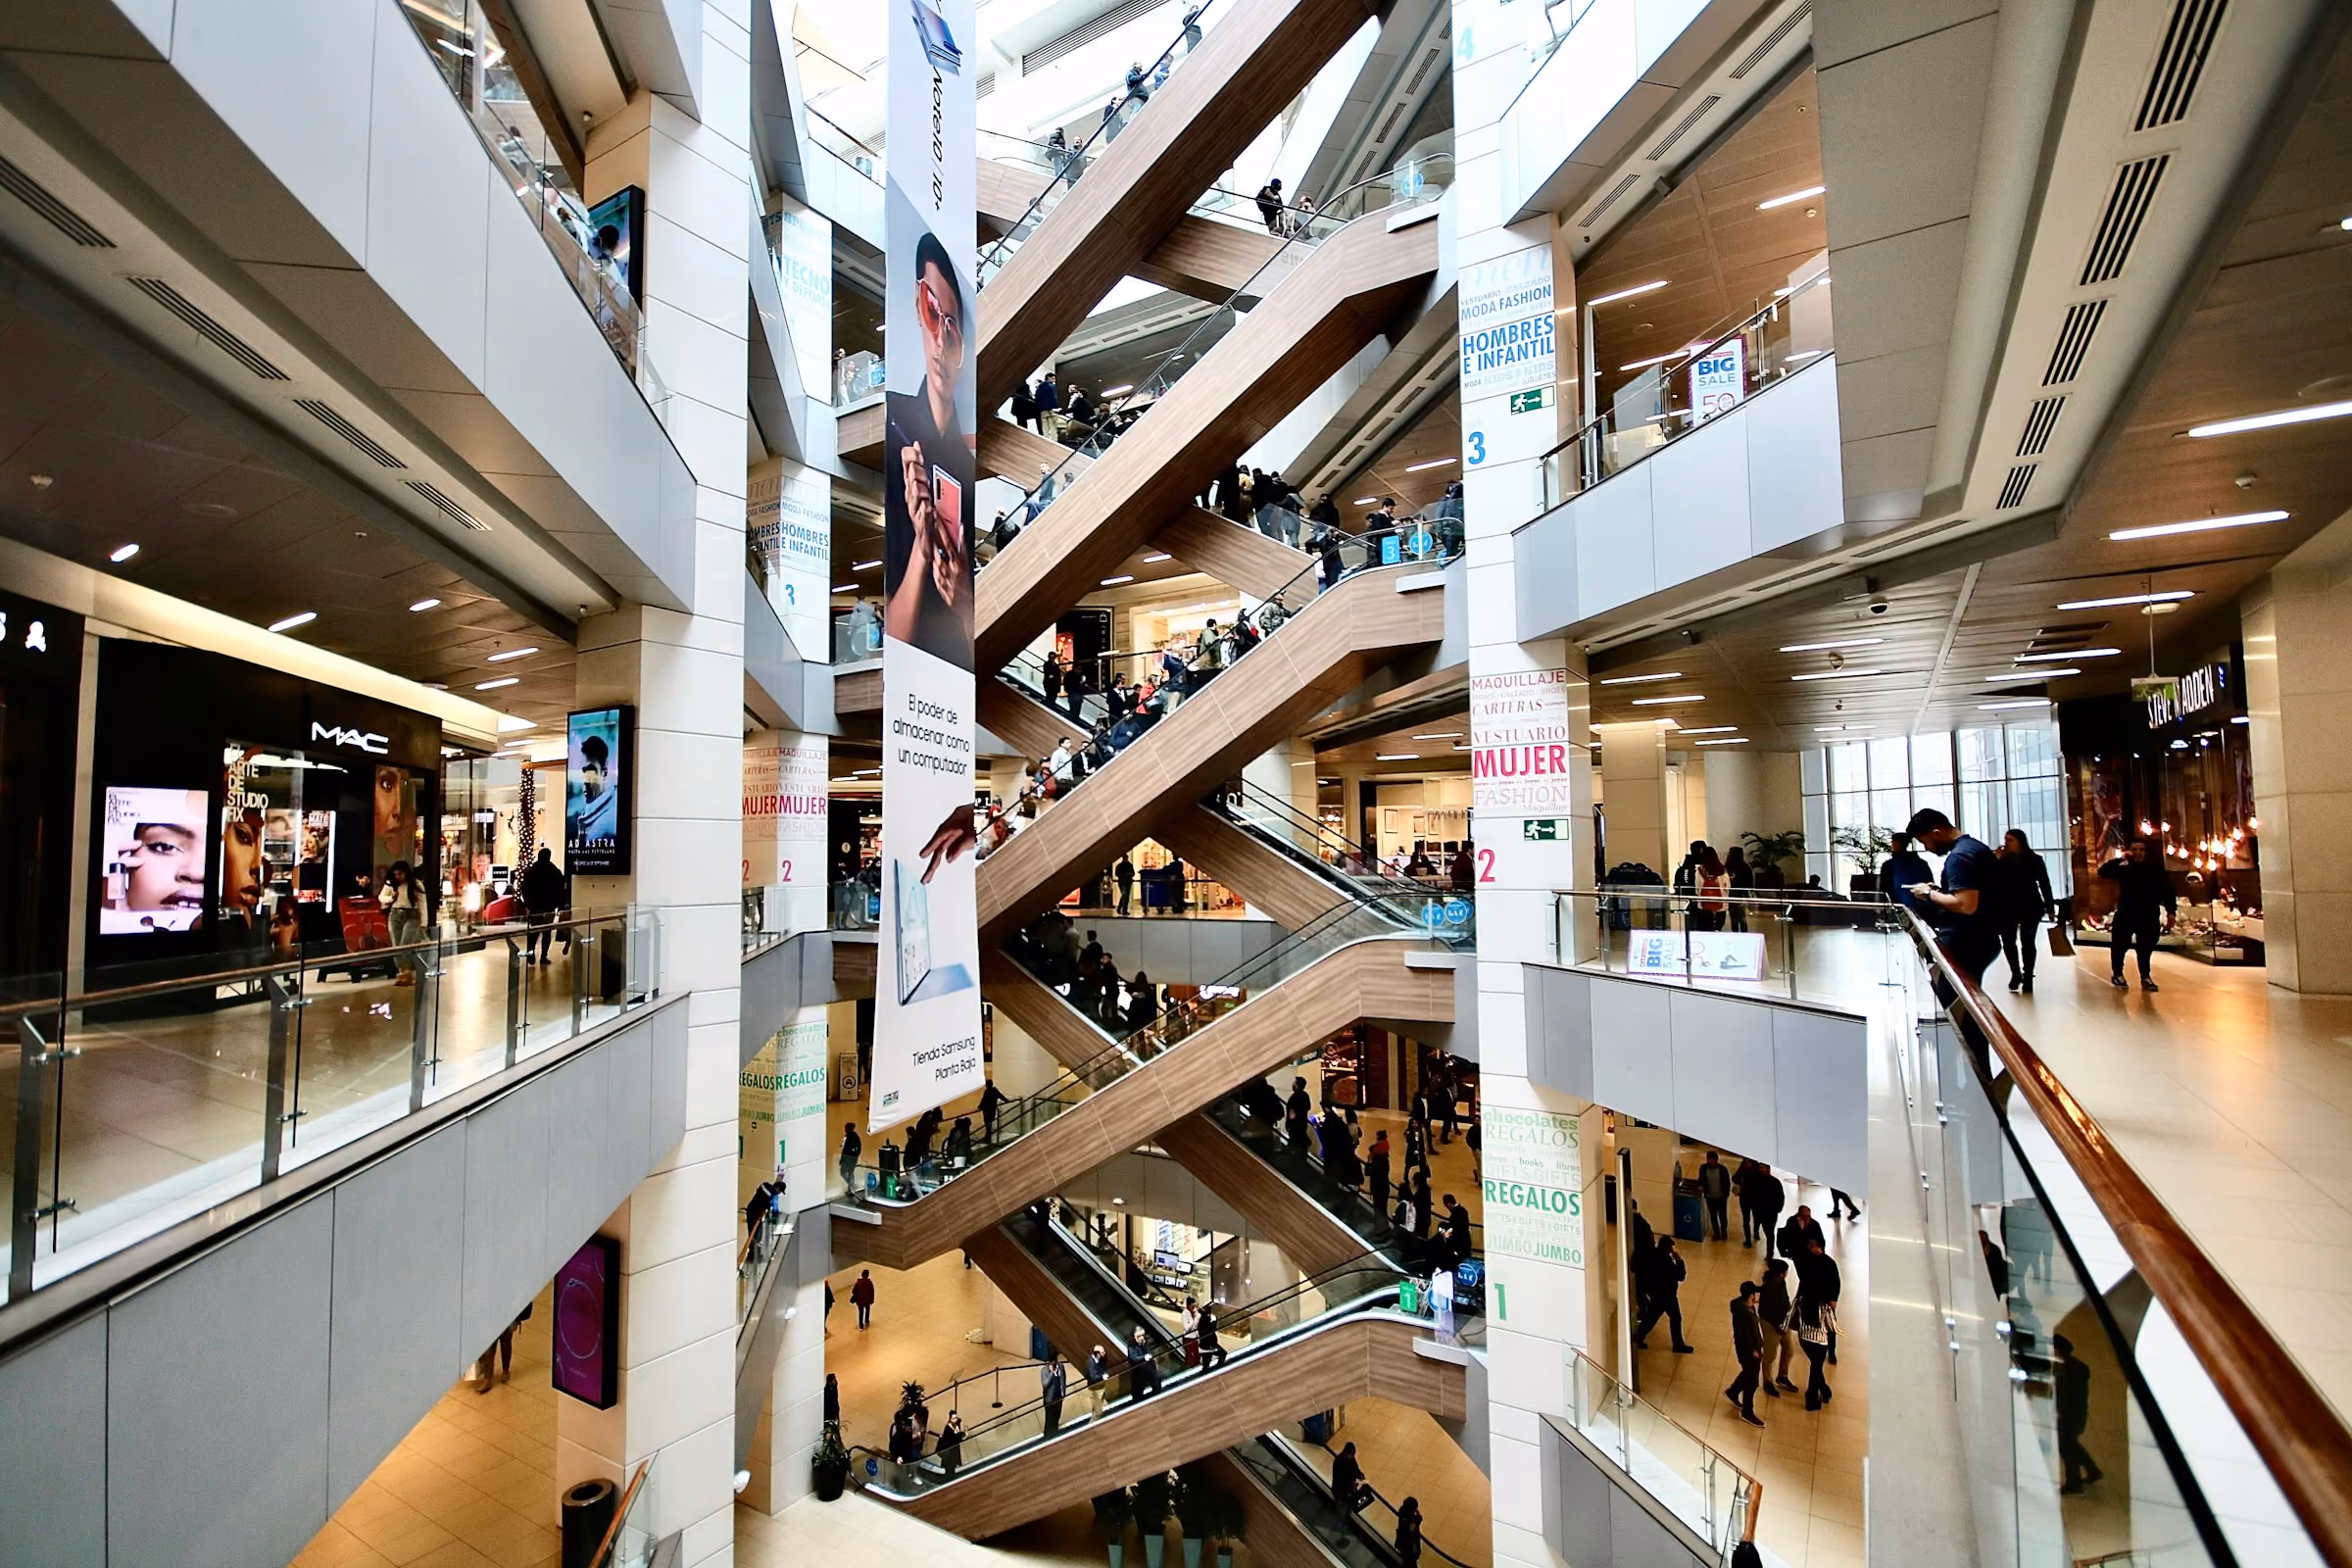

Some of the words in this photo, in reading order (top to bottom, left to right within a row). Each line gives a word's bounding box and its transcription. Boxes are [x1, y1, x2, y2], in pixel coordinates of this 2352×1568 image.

[1457, 25, 1474, 61] 4
[932, 65, 943, 162] Note10
[783, 256, 830, 295] TECNO
[1460, 289, 1501, 306] VESTUARIO
[1461, 300, 1496, 320] MODA
[1499, 284, 1551, 311] FASHION
[1463, 315, 1553, 356] HOMBRES
[1464, 357, 1471, 374] E
[1478, 336, 1554, 370] INFANTIL
[1698, 358, 1735, 375] BIG
[1464, 379, 1482, 388] MODA
[1699, 373, 1737, 386] SALE
[1468, 431, 1486, 465] 3
[782, 502, 801, 514] MODA
[803, 508, 829, 523] FASHION
[782, 522, 829, 547] HOMBRES
[782, 537, 786, 549] E
[789, 540, 829, 561] INFANTIL
[1387, 546, 1396, 560] 3
[785, 584, 796, 606] 3
[1472, 670, 1565, 691] MAQUILLAJE
[908, 694, 916, 711] El
[917, 700, 946, 721] poder
[947, 708, 958, 725] de
[1472, 699, 1543, 715] CARTERAS
[893, 717, 945, 745] almacenar
[946, 735, 970, 753] como
[1473, 725, 1566, 745] VESTUARIO
[779, 748, 826, 761] MAQUILLAJE
[899, 748, 911, 764] un
[912, 753, 967, 776] computador
[1474, 745, 1567, 778] MUJER
[228, 760, 259, 778] ARTE
[744, 766, 769, 775] ARTERAS
[779, 765, 815, 775] CARTERAS
[228, 775, 245, 792] DE
[744, 783, 777, 794] ESTUARIO
[227, 792, 269, 808] STUDIO
[779, 795, 826, 815] MUJER
[1475, 785, 1568, 806] FASHION
[226, 807, 244, 822] FIX
[568, 839, 580, 848] AD
[585, 838, 615, 848] ASTRA
[782, 859, 792, 882] 2
[1478, 849, 1496, 883] 2
[1646, 938, 1663, 967] BIG
[912, 1046, 941, 1066] Tienda
[941, 1036, 975, 1057] Samsung
[776, 1067, 825, 1090] REGALOS
[935, 1062, 959, 1082] Planta
[959, 1056, 976, 1073] Baja
[756, 1111, 775, 1122] JUMBO
[802, 1102, 825, 1117] JUMBO
[1484, 1108, 1579, 1130] chocolates
[1486, 1123, 1579, 1149] REGALOS
[778, 1140, 786, 1163] 1
[1519, 1156, 1544, 1167] books
[1535, 1169, 1581, 1187] GIFTS
[1485, 1180, 1580, 1216] REGALOS
[1534, 1243, 1581, 1263] JUMBO
[1403, 1293, 1411, 1309] 1
[1494, 1283, 1507, 1321] 1
